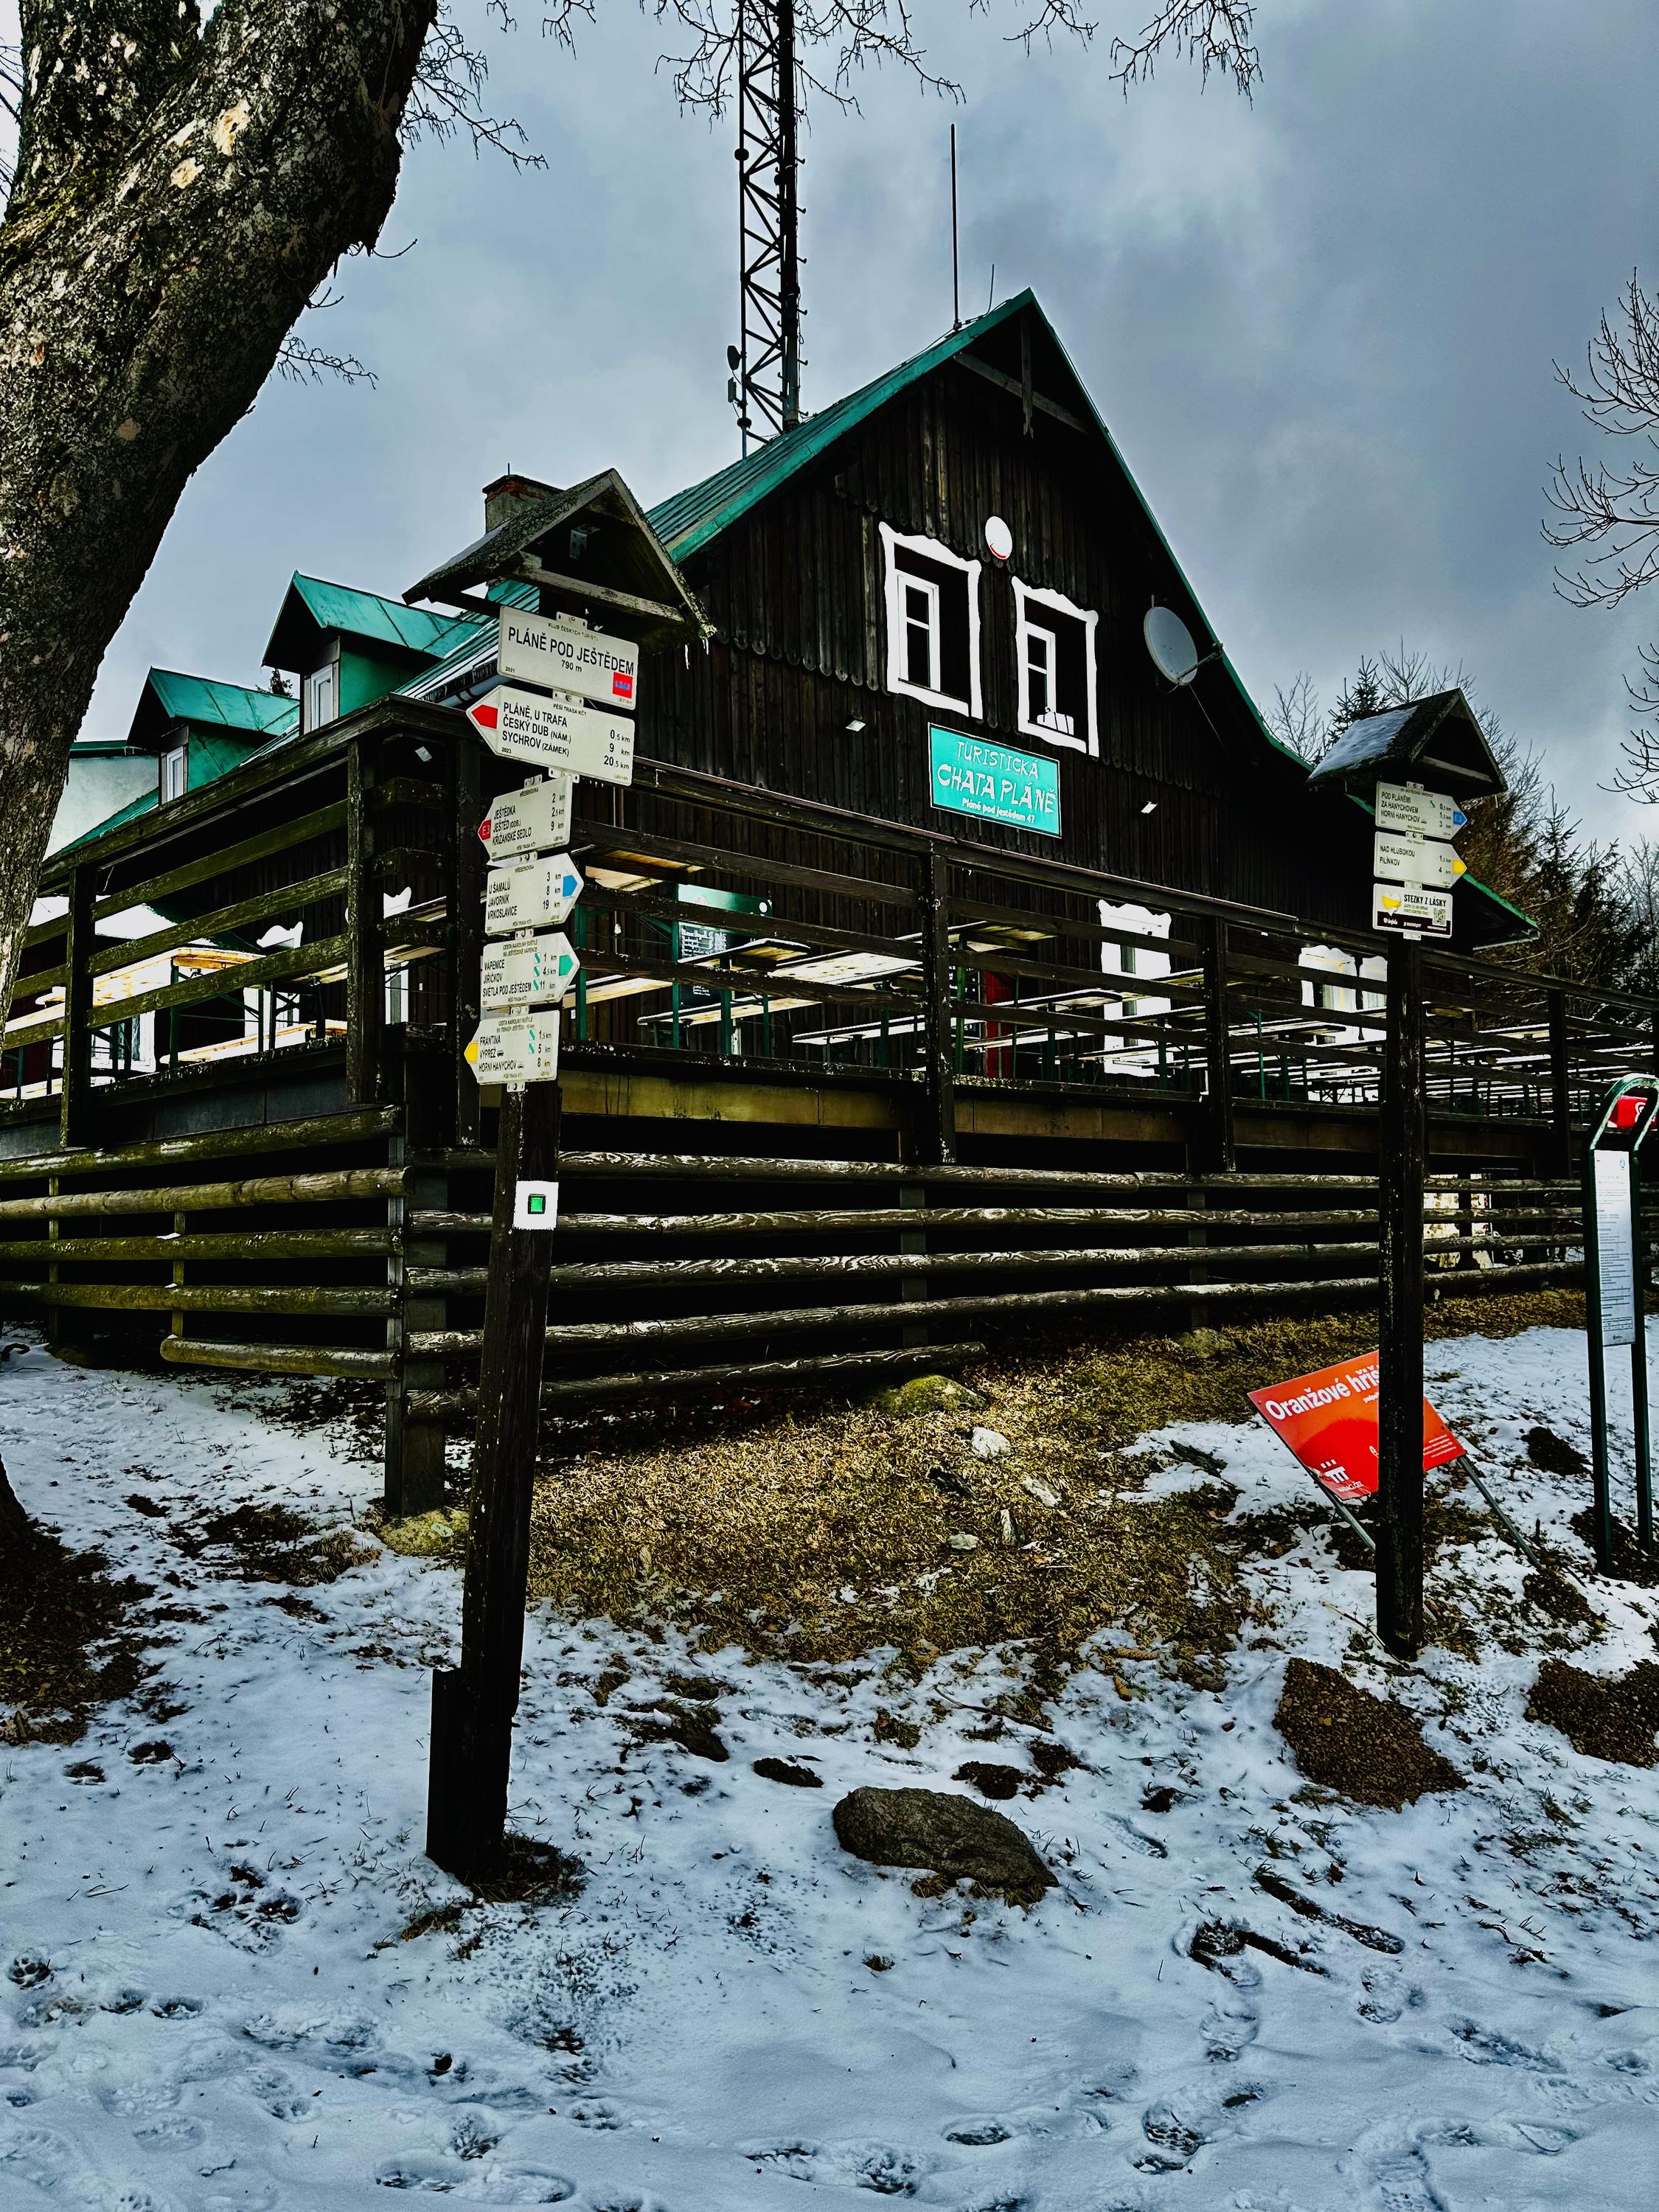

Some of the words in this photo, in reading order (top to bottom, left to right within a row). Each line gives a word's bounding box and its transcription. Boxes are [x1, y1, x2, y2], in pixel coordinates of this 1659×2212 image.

[508, 627, 546, 651] PLÁNĚ
[550, 639, 574, 658] POD
[577, 647, 634, 675] JEŠTĚDEM
[561, 660, 574, 670] 790
[504, 702, 532, 720] PLÁNĚ,
[535, 709, 540, 720] U
[543, 713, 568, 728] TRAFA
[563, 706, 578, 715] TRASA
[503, 715, 530, 733] ČESKÝ
[532, 723, 549, 737] DUB
[550, 731, 571, 743] (NÁM.)
[502, 731, 541, 749] SYCHROV
[542, 742, 569, 757] (ZÁMEK)
[622, 735, 630, 743] km
[609, 743, 614, 753] 9
[621, 748, 630, 757] km
[957, 741, 1038, 779] TURISTICKÁ
[937, 763, 995, 800] CHATA
[1000, 779, 1057, 814] PLÁNĚ
[552, 793, 556, 804] 2
[1381, 791, 1391, 801] POD
[559, 808, 565, 816] km
[961, 797, 981, 811] Pláně
[982, 801, 995, 814] pod
[1026, 813, 1035, 823] 47
[1381, 801, 1388, 809] ZA
[1388, 802, 1419, 813] HANYCHOVEM
[1396, 813, 1420, 824] HANYCHOV
[481, 824, 490, 836] E3
[493, 818, 509, 833] JEŠTĚD
[550, 821, 554, 832] 9
[517, 827, 532, 841] SEDLO
[1380, 844, 1391, 855] NAD
[1391, 846, 1416, 858] HLUBOKOU
[1380, 857, 1400, 866] PILÍNKOV
[546, 872, 551, 881] 3
[489, 885, 493, 894] U
[546, 886, 550, 896] 8
[543, 900, 549, 910] 19
[1404, 894, 1424, 905] STEZKY
[1425, 897, 1429, 905] Z
[1429, 897, 1447, 908] LÁSKY
[487, 905, 518, 920] VRKOSLAVICE
[543, 953, 547, 962] 1
[484, 959, 505, 971] VÁPENICE
[498, 984, 508, 995] POD
[540, 981, 545, 990] 11
[480, 1034, 501, 1046] FRANTINA
[538, 1044, 542, 1054] 5
[493, 1059, 517, 1071] HANYCHOV
[538, 1058, 541, 1068] 8
[1265, 1377, 1351, 1420] Oranžové
[1345, 1364, 1380, 1394] hřiš
